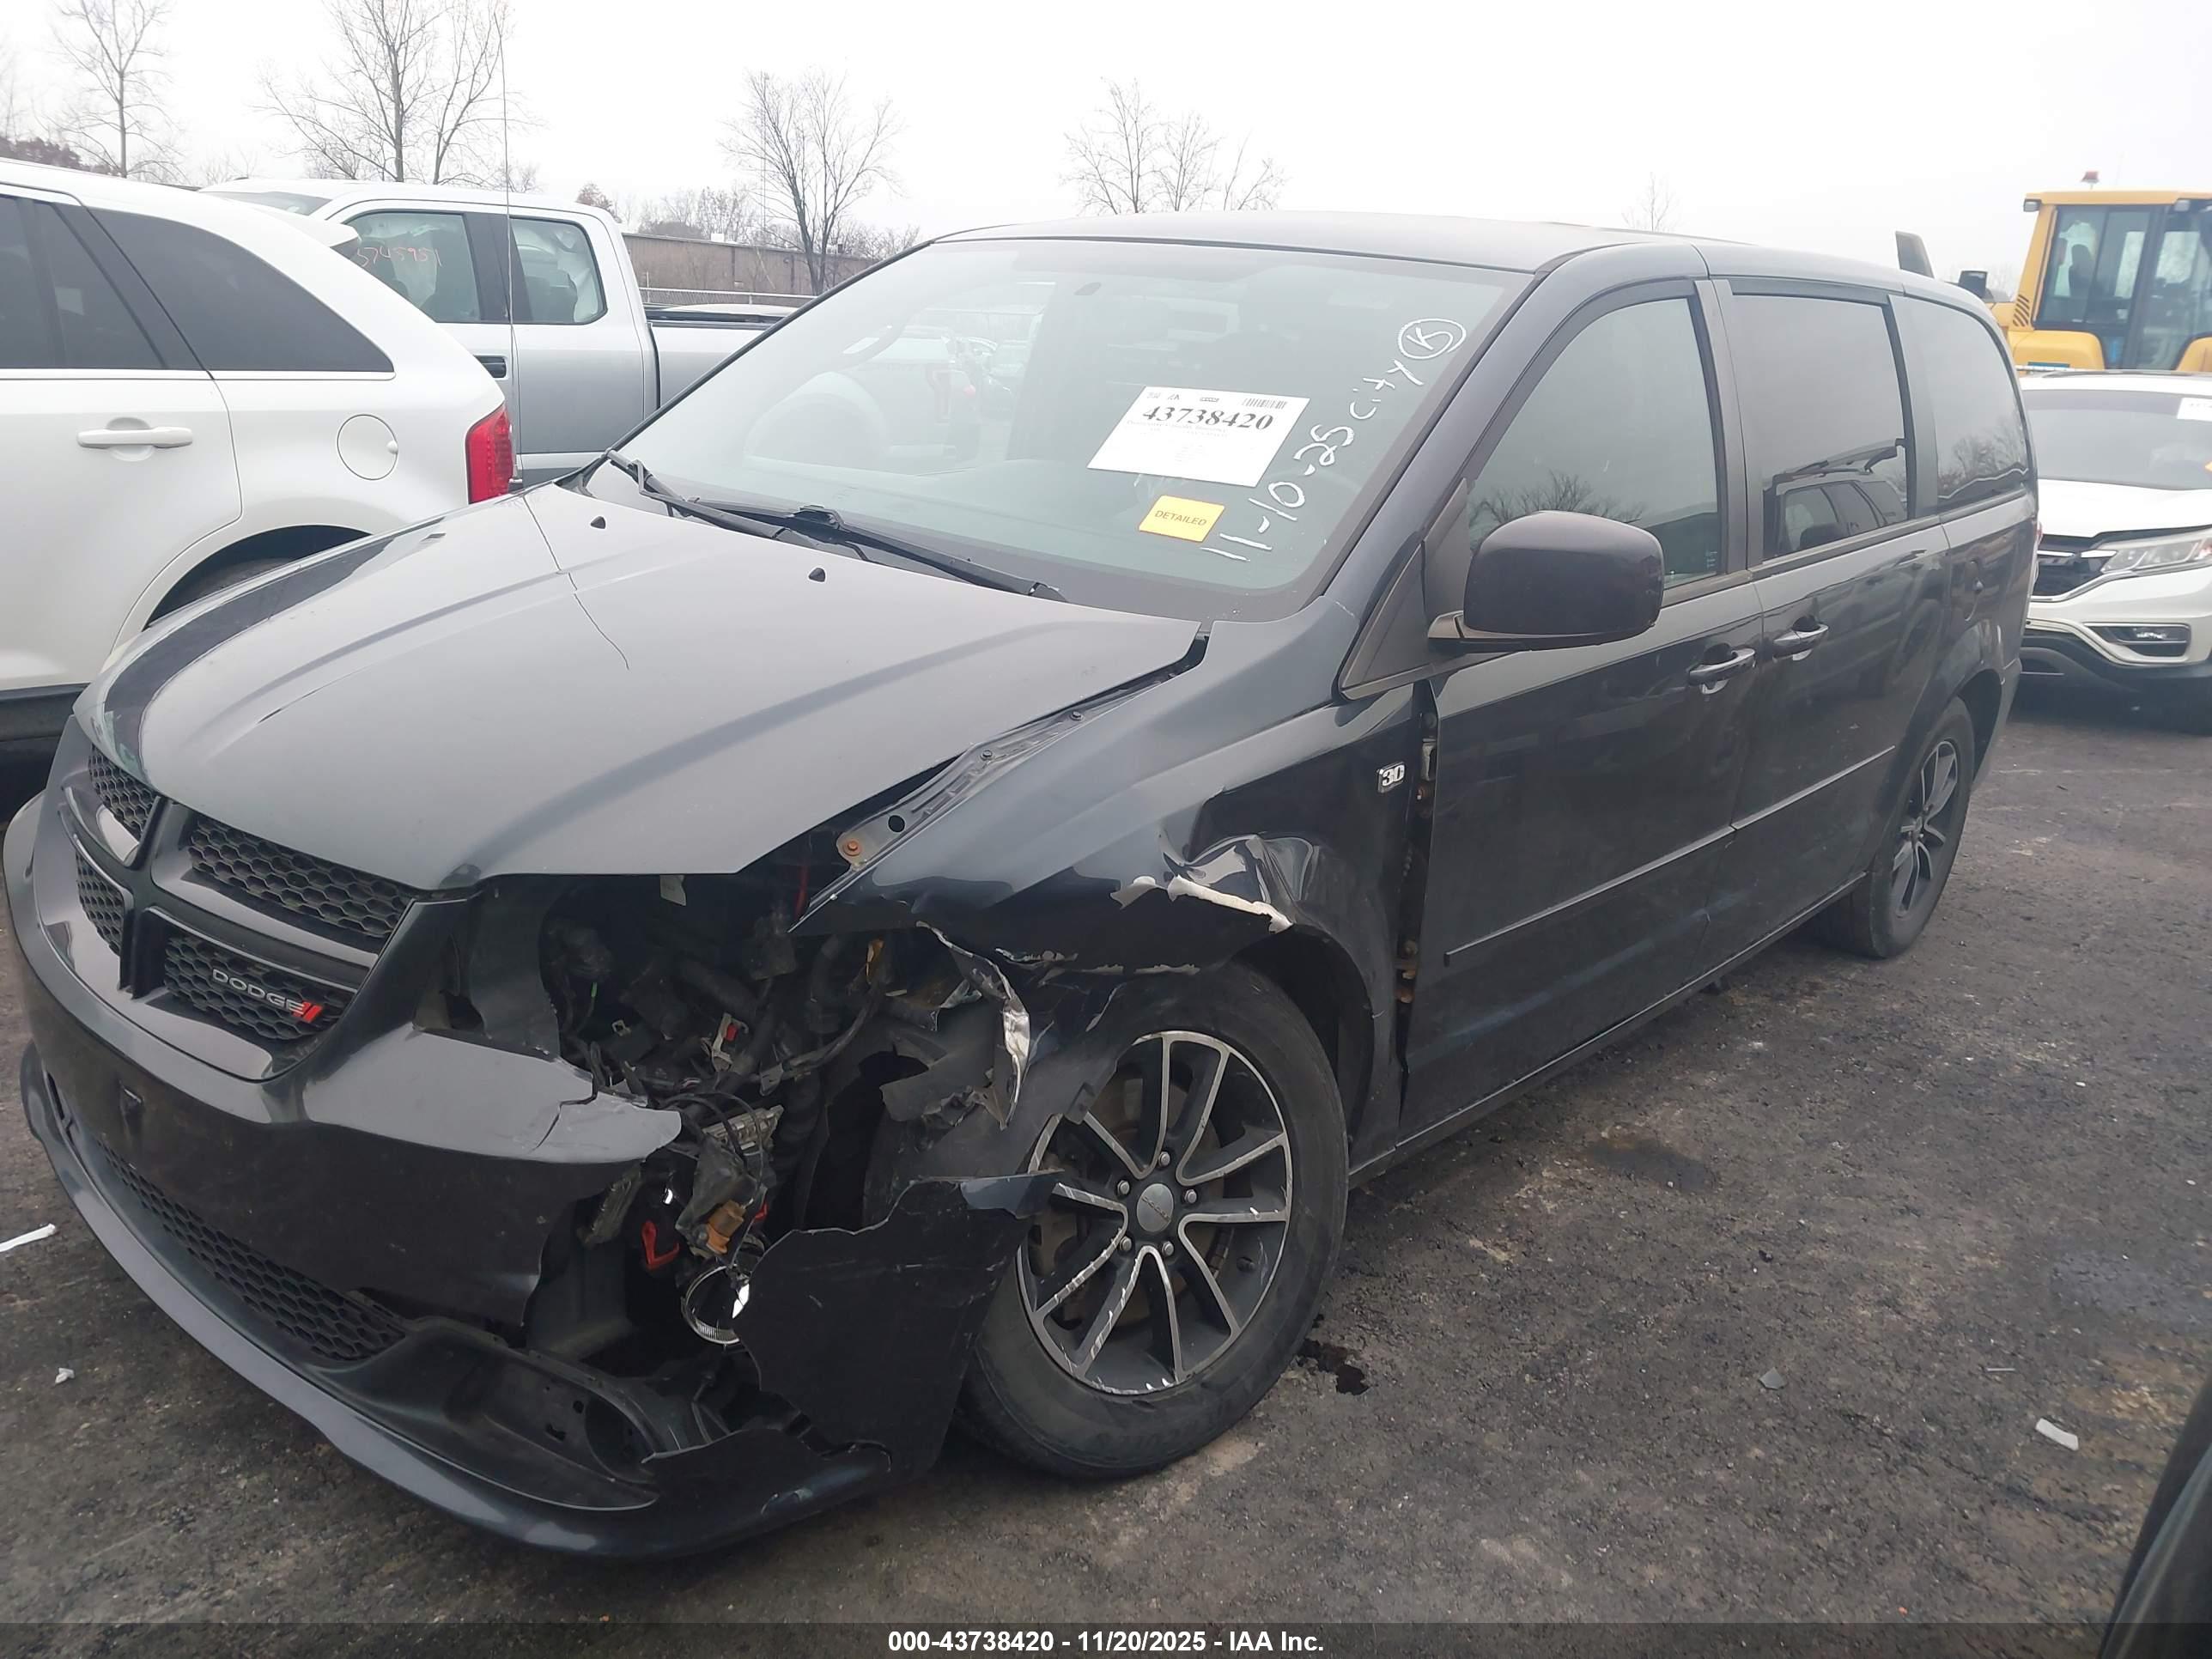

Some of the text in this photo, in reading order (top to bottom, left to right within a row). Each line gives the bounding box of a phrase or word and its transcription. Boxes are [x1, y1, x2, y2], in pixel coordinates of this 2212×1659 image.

[1142, 406, 1274, 430] 43738420
[1155, 510, 1207, 526] DETAILED
[1381, 763, 1406, 787] 30
[213, 968, 305, 1016] DODGE
